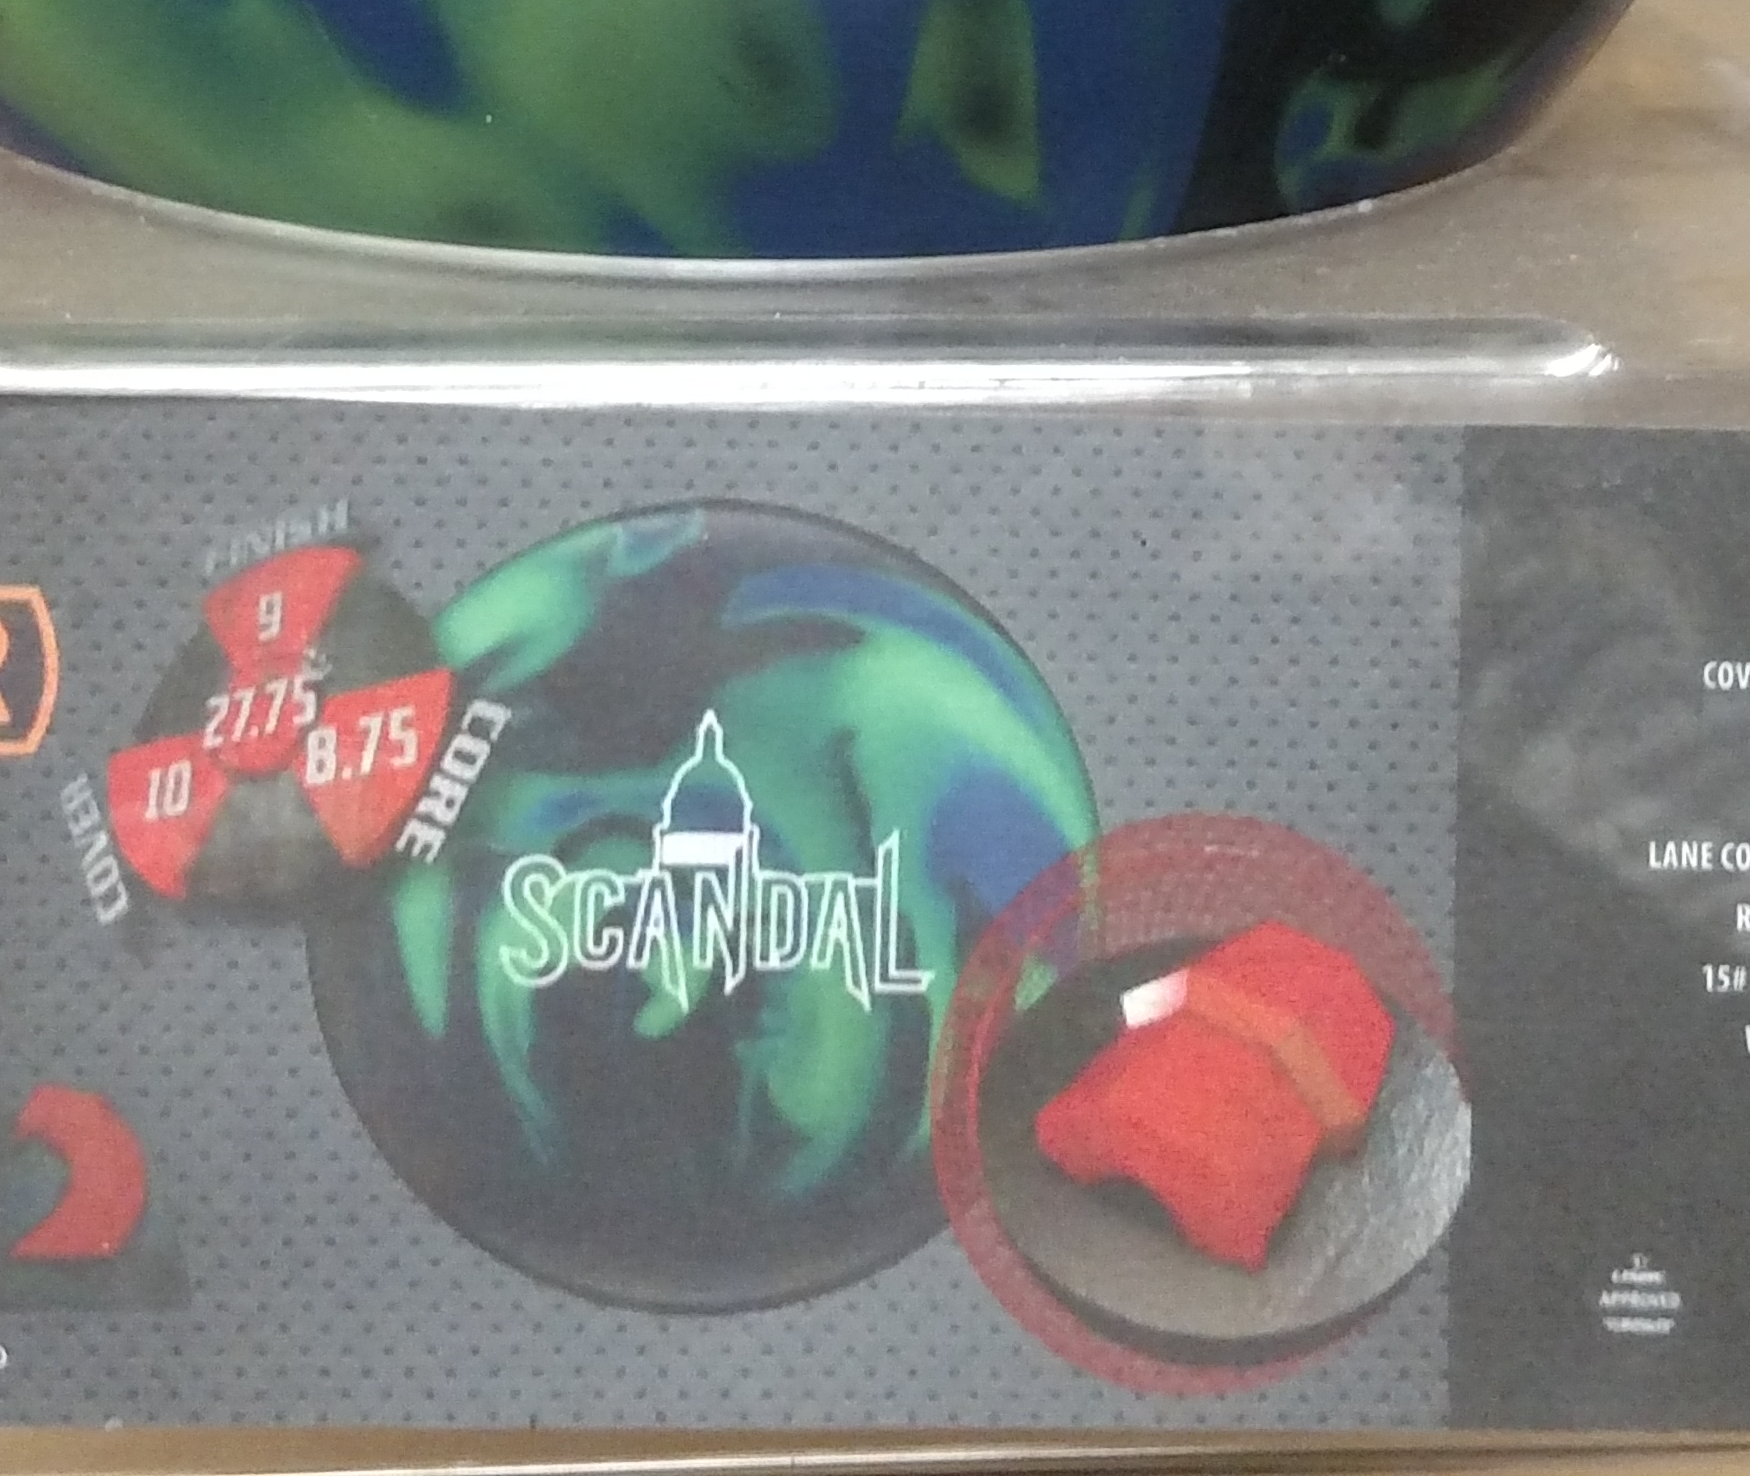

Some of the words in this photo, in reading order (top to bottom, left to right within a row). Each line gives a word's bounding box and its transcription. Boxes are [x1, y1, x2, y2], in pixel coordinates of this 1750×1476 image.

[256, 590, 284, 642] 9
[202, 673, 318, 751] 27.75
[304, 705, 420, 787] 8.75
[144, 758, 192, 822] 10
[395, 697, 513, 865] CORE
[59, 771, 131, 926] COVER
[1648, 840, 1714, 871] LANE
[498, 827, 936, 1015] SCANDAL
[1701, 962, 1748, 993] 15#
